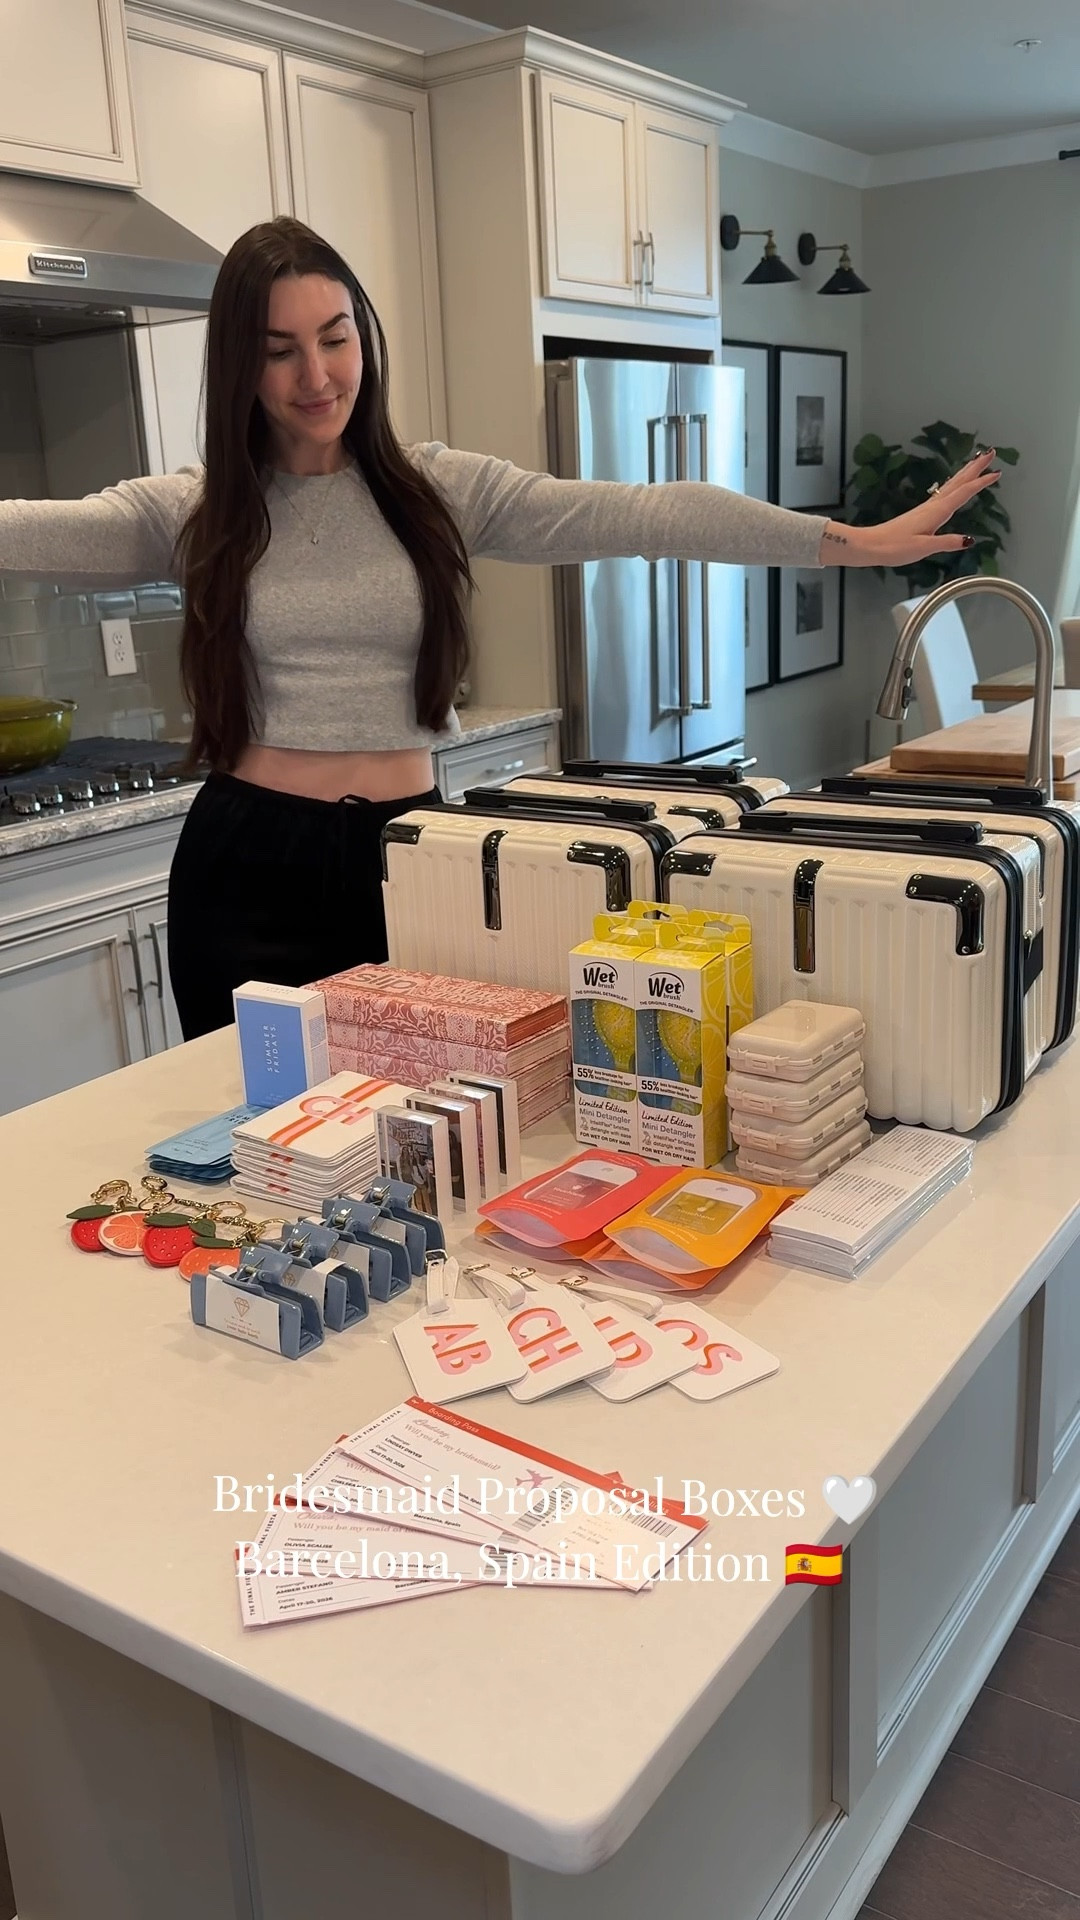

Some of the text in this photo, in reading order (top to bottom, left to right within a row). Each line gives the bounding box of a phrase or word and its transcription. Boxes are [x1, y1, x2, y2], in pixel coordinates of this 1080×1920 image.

[36, 260, 83, 271] KitchenAid
[350, 971, 417, 993] slip
[583, 967, 616, 987] Wet
[598, 982, 614, 990] brush
[648, 977, 681, 998] Wet
[663, 993, 681, 1001] brush
[263, 1025, 273, 1072] SUMMER
[577, 1068, 594, 1080] 55%
[641, 1080, 659, 1092] 55%
[299, 1095, 376, 1126] CH
[579, 1097, 628, 1114] Limited Edition
[580, 1108, 631, 1124] Mini Detangler
[641, 1110, 694, 1129] Limited Edition
[642, 1121, 696, 1139] Mini Detangler
[423, 1323, 491, 1375] AB
[508, 1307, 584, 1374] CH
[350, 1410, 401, 1444] THE FINAL FIESTA
[428, 1407, 479, 1434] Boarding Pass
[404, 1423, 501, 1471] Will you be my bridesmaid?
[305, 1451, 336, 1481] FINAL FIESTA
[264, 1513, 278, 1532] FIESTA
[293, 1522, 314, 1530] Will
[315, 1524, 333, 1532] you
[335, 1522, 347, 1530] be
[350, 1525, 364, 1533] my
[366, 1525, 389, 1533] maid
[276, 1580, 333, 1595] AMBER STEFANO
